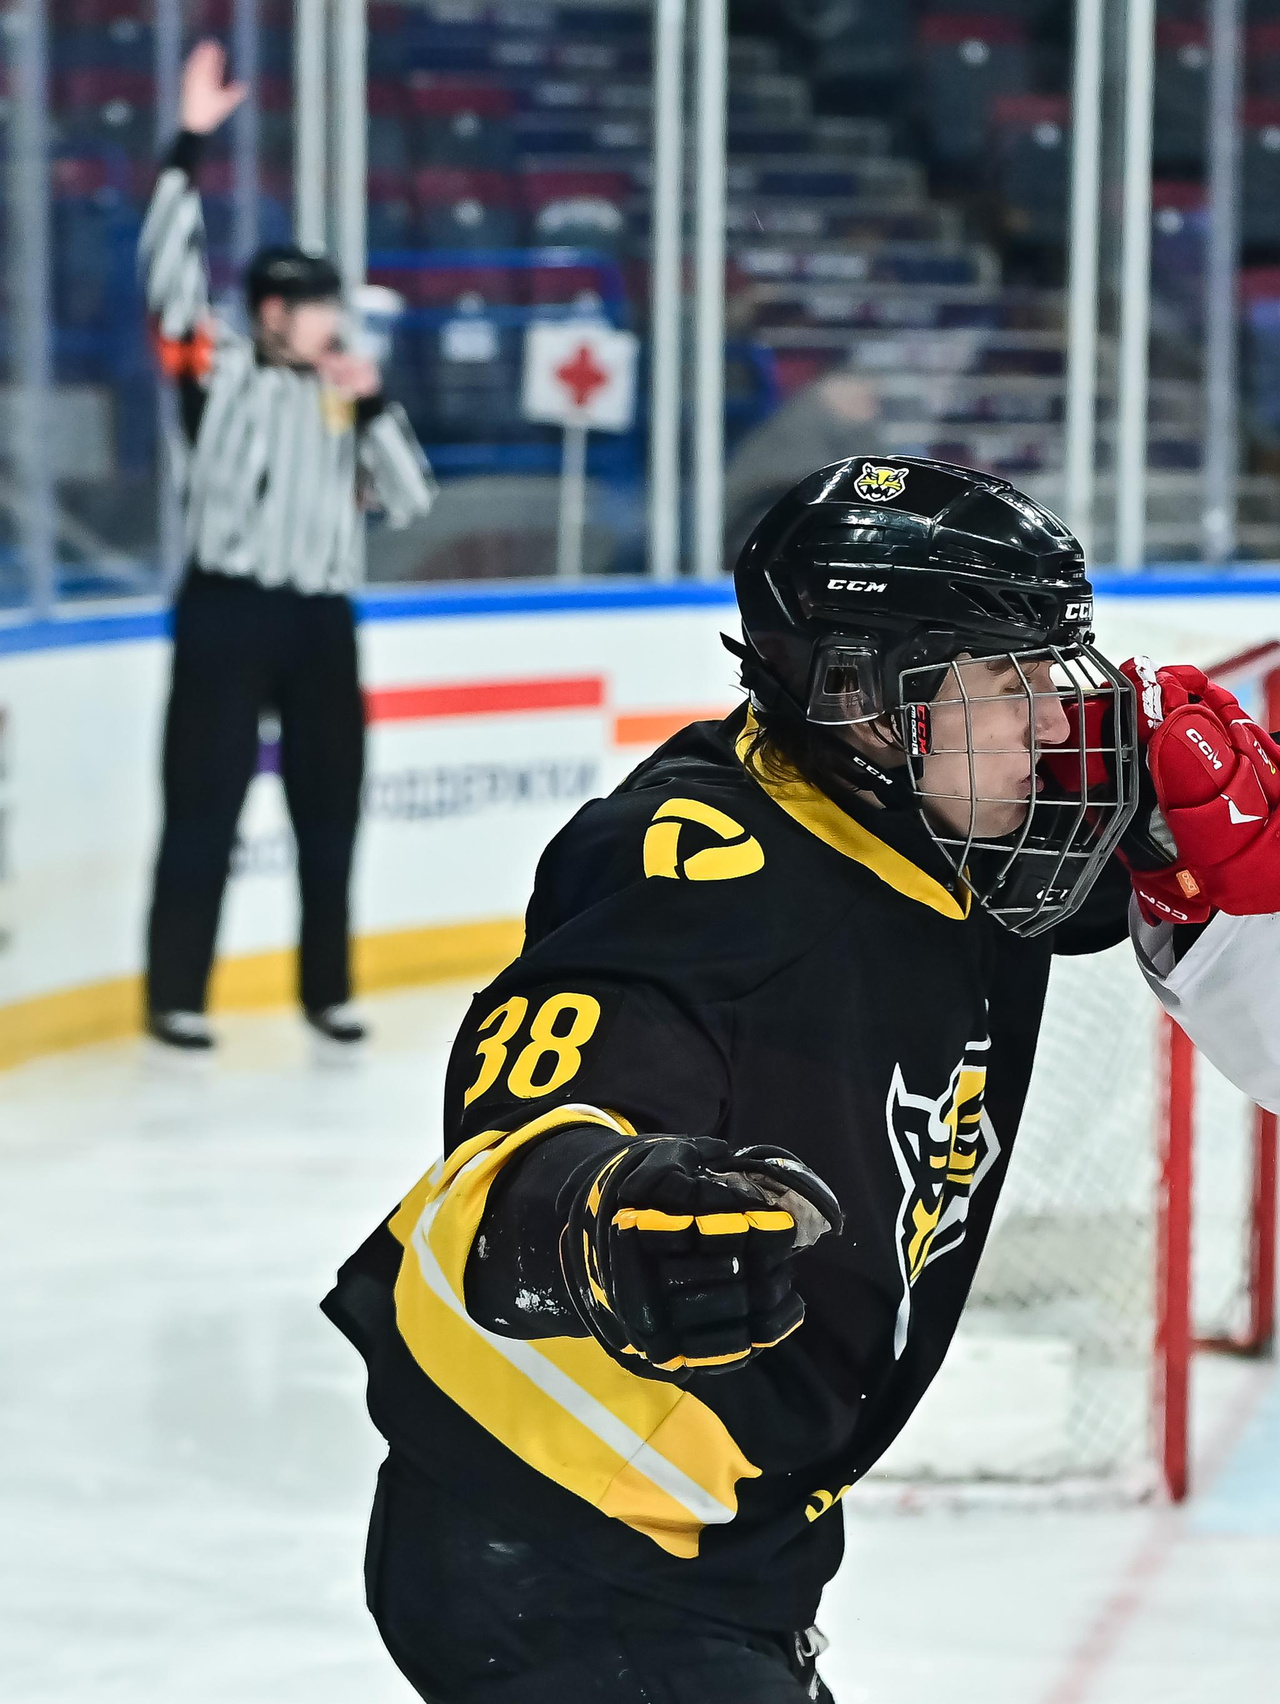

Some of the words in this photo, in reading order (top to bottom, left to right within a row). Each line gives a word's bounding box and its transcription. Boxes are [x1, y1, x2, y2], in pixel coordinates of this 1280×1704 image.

[826, 577, 888, 594] CCM
[916, 704, 928, 755] CCM
[1184, 727, 1223, 771] CCM
[852, 755, 894, 786] CCM
[1139, 890, 1188, 921] CCM
[463, 991, 601, 1105] 38
